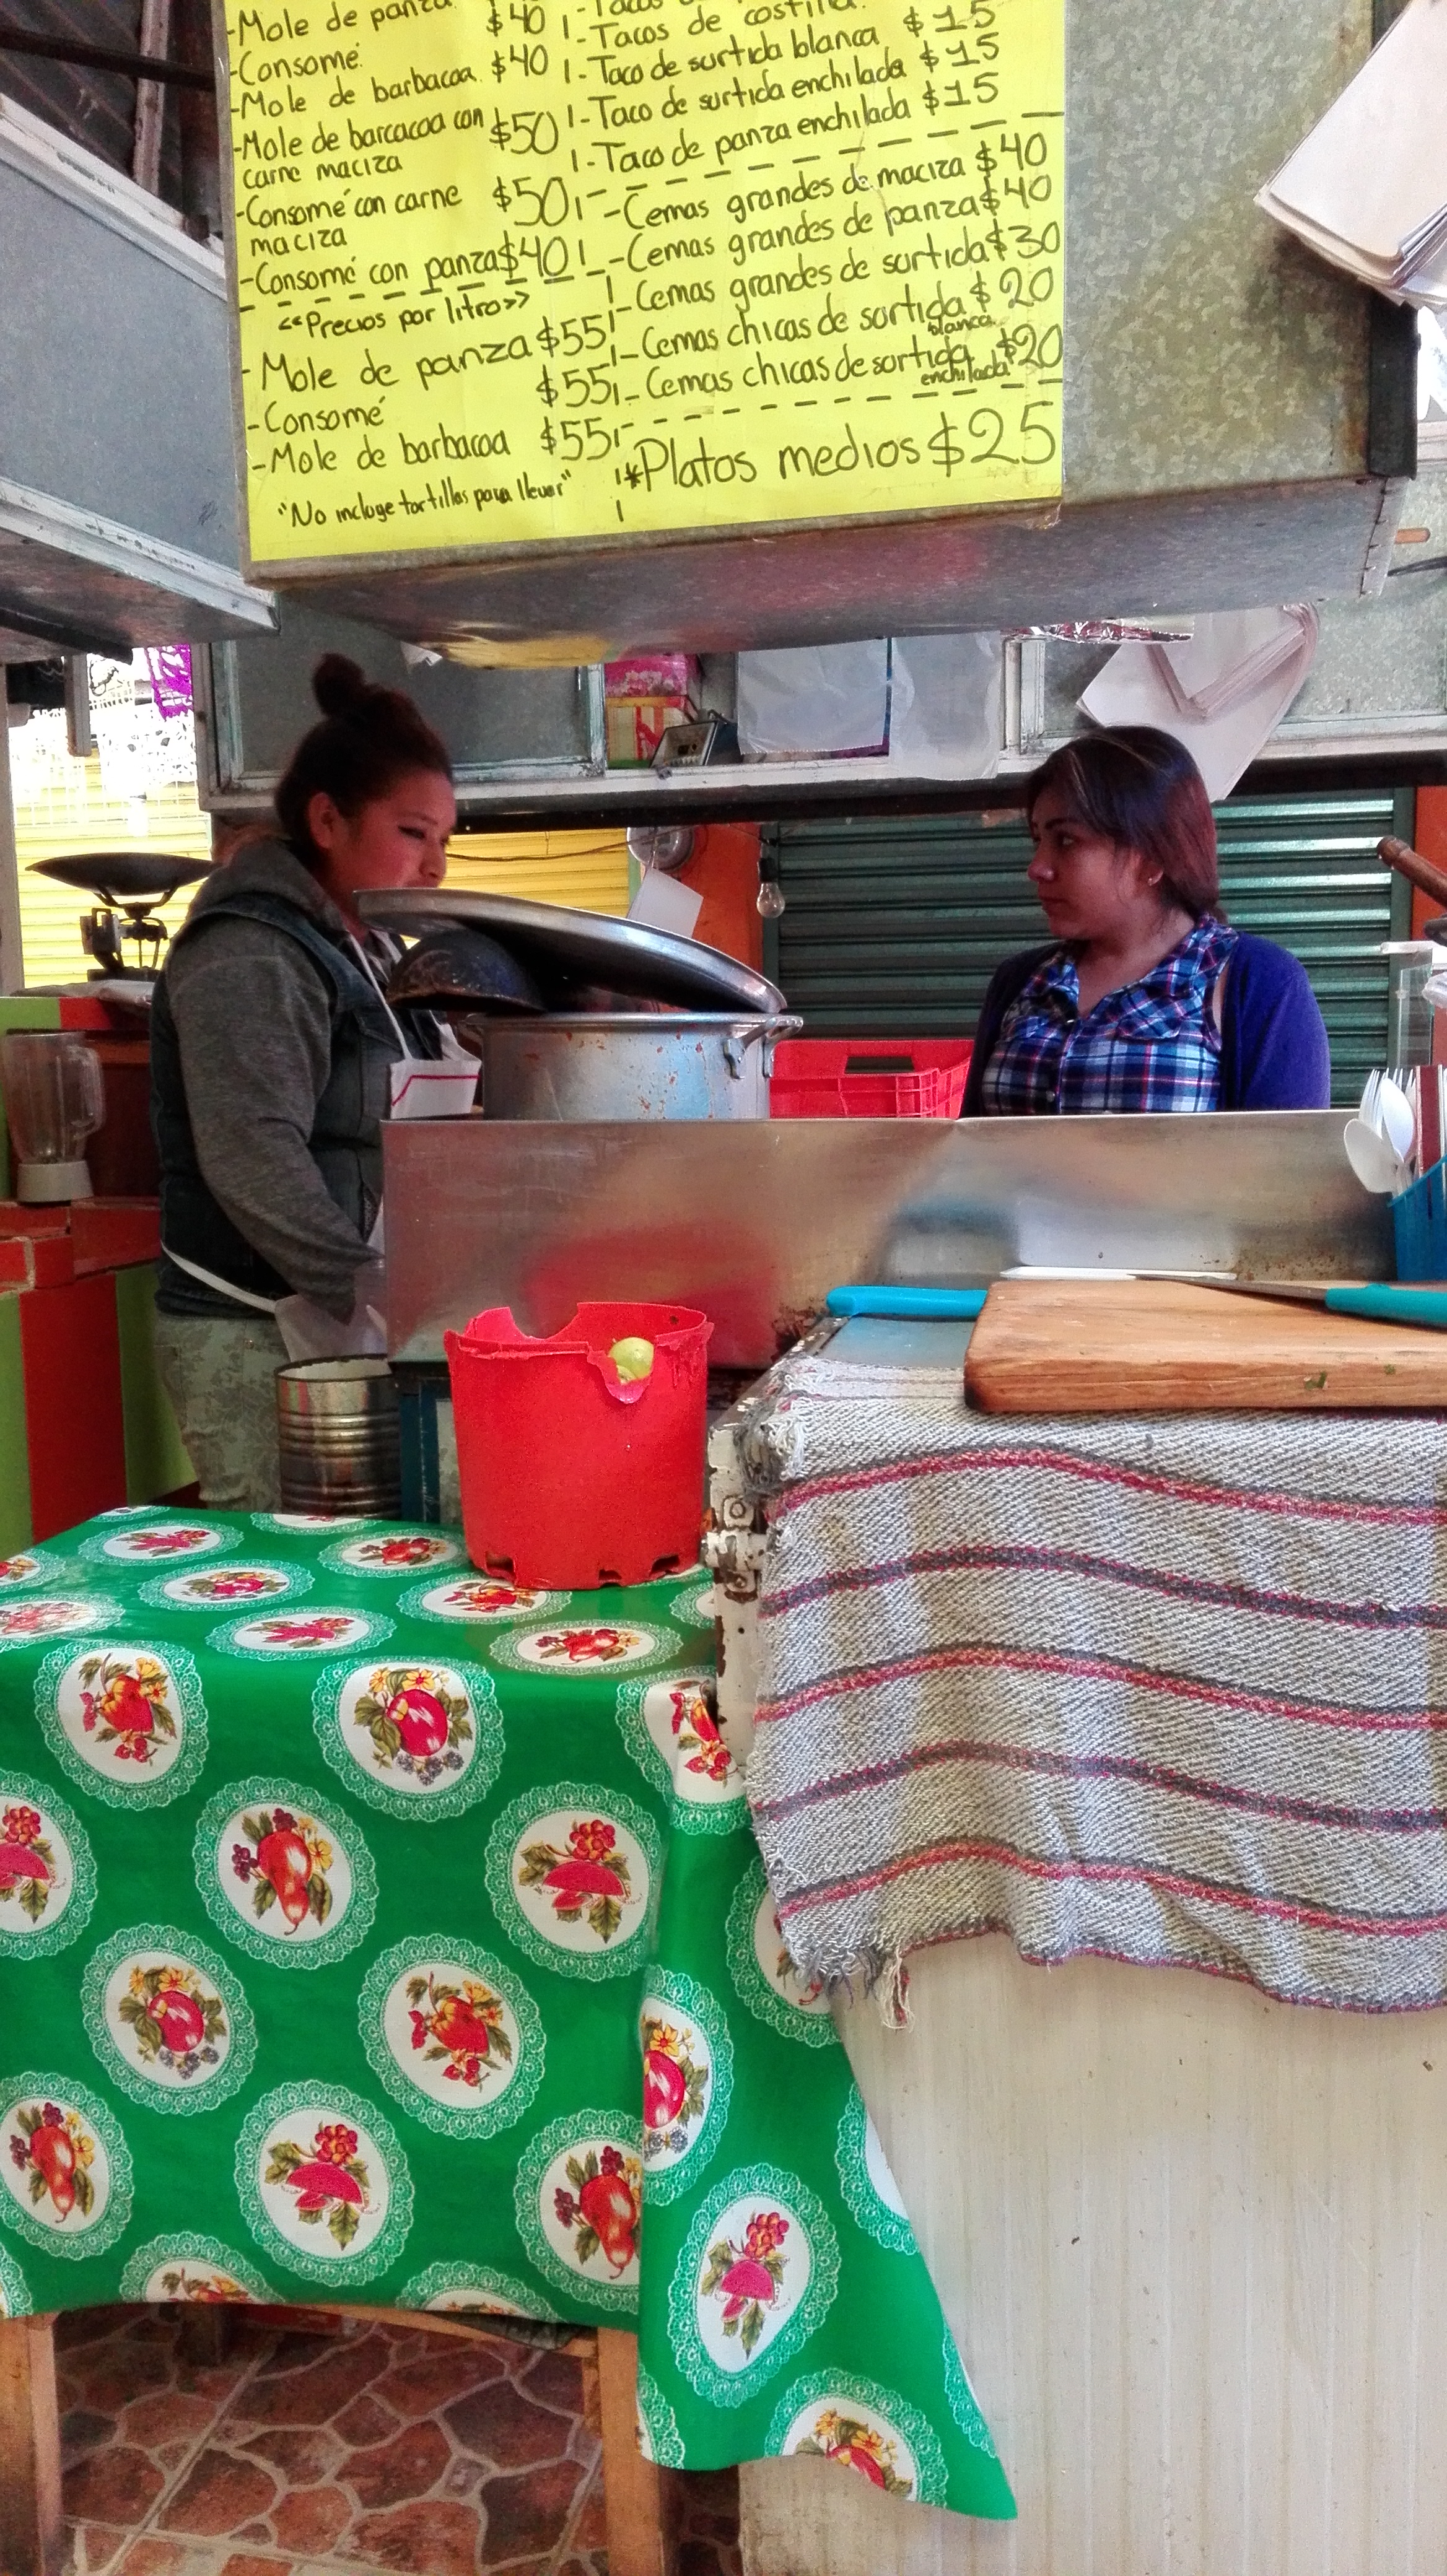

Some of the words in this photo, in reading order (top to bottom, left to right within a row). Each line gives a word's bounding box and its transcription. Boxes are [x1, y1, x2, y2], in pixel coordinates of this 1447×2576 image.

[326, 1, 358, 32] de
[487, 6, 546, 36] $40
[650, 48, 683, 81] de
[791, 24, 881, 63] blanca
[903, 0, 996, 37] $15
[688, 4, 722, 35] de
[329, 76, 356, 108] de
[491, 45, 548, 83] $40
[660, 85, 688, 118] de
[790, 46, 907, 98] enchilada
[919, 32, 1000, 74] $15
[312, 122, 340, 154] de
[348, 113, 447, 148] barcacoa
[453, 107, 484, 129] con
[489, 107, 559, 155] $50
[671, 128, 705, 165] de
[715, 120, 793, 167] panza
[797, 85, 912, 138] enchilada
[922, 71, 1000, 118] $15
[242, 167, 301, 190] carne
[317, 155, 403, 181] maciza
[354, 194, 386, 217] con
[395, 184, 462, 214] carne
[492, 175, 569, 227] $50
[726, 171, 834, 224] grandes
[842, 163, 874, 191] de
[877, 157, 966, 188] maciza
[976, 131, 1047, 175] $40
[250, 227, 347, 257] maciza
[728, 210, 834, 266] grandes
[843, 201, 874, 235] de
[886, 194, 980, 235] panza
[980, 174, 1052, 217] $40
[369, 259, 409, 284] con
[424, 249, 499, 291] panza
[498, 230, 570, 279] $40
[730, 253, 833, 311] grandes
[840, 247, 871, 282] de
[986, 219, 1060, 260] $30
[399, 308, 433, 333] por
[726, 310, 811, 356] chicas
[818, 293, 850, 333] de
[971, 265, 1054, 308] $20
[360, 349, 400, 387] de
[416, 334, 532, 390] panza
[536, 314, 607, 356] $55
[743, 352, 830, 389] chicas
[835, 342, 868, 378] de
[997, 323, 1063, 368] $20
[536, 363, 612, 408] $55
[357, 434, 387, 470] de
[398, 422, 511, 466] barbacoa
[540, 416, 611, 461] $55
[778, 425, 920, 480] medios
[928, 401, 1055, 477] $25
[398, 476, 469, 516] tortillas
[473, 487, 512, 512] para
